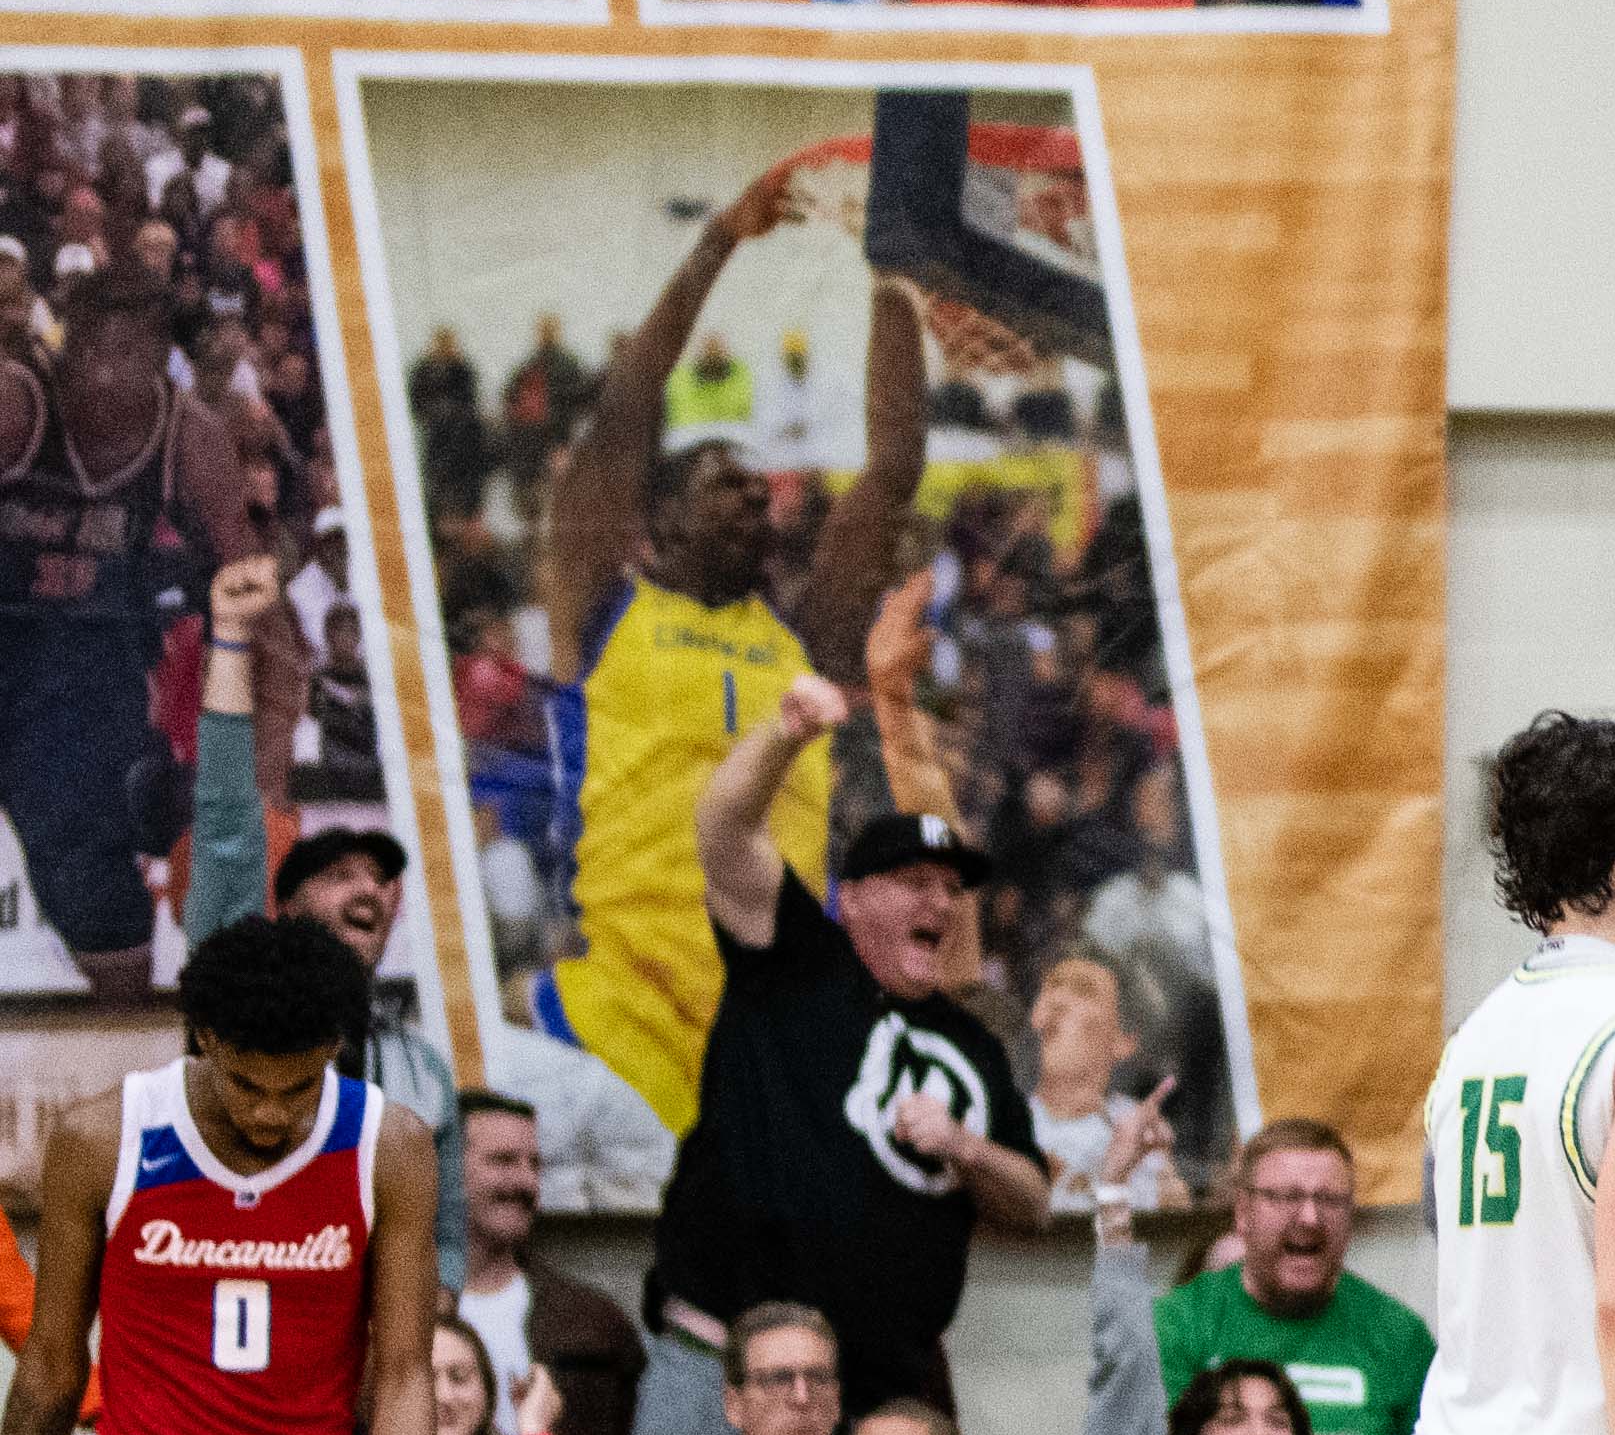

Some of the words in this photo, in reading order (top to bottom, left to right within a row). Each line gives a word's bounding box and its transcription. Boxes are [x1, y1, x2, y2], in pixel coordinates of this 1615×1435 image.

[1459, 1073, 1528, 1228] 15
[133, 1219, 352, 1271] Duncanville
[211, 1277, 272, 1373] 0
